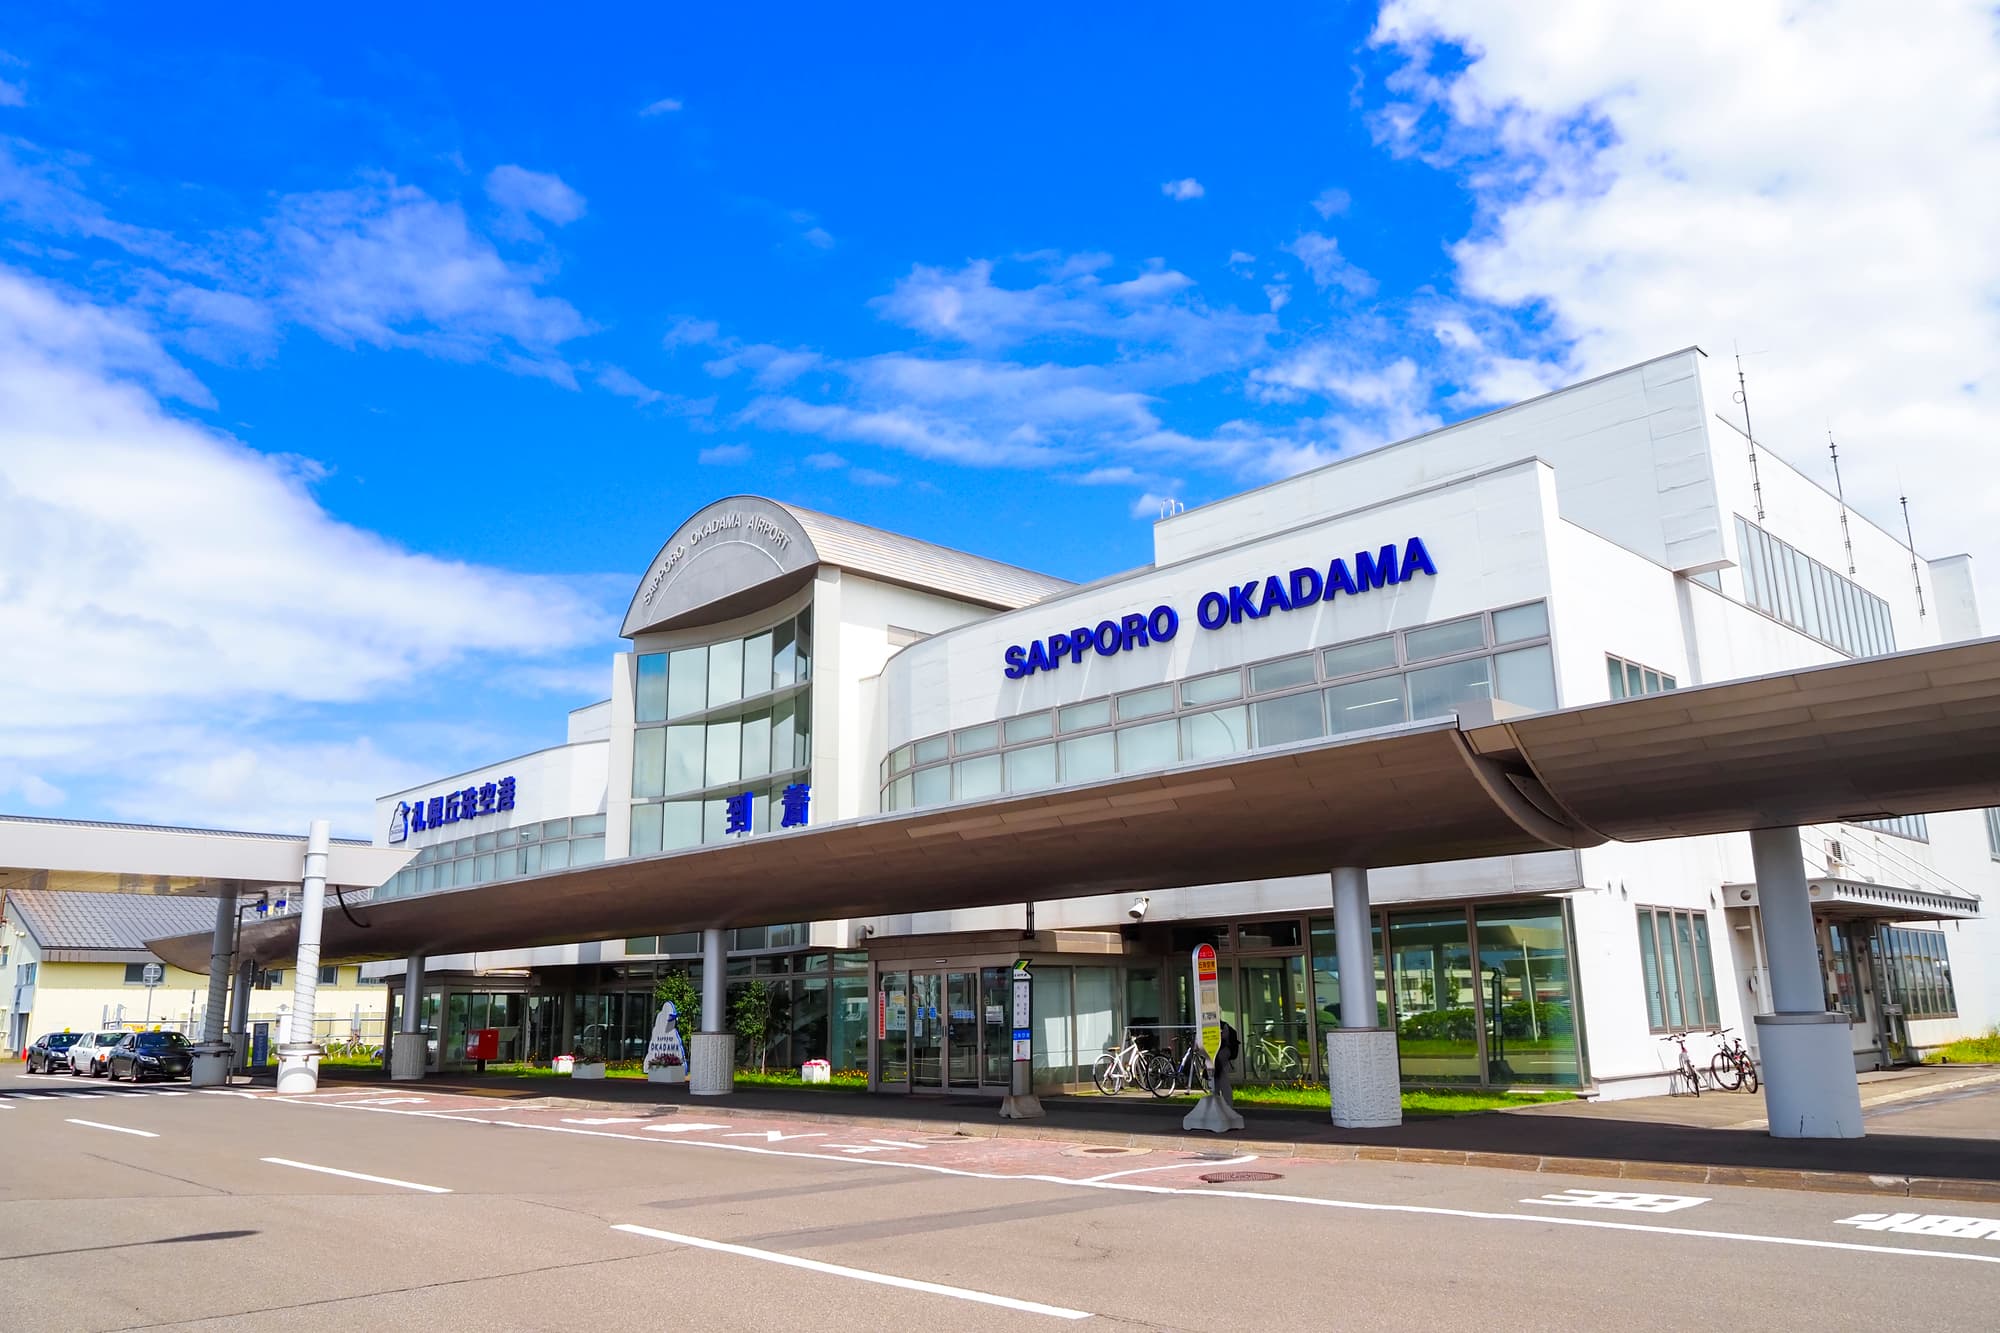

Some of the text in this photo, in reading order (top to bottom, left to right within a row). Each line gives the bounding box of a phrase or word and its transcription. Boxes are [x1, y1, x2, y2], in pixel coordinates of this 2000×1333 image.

[644, 513, 792, 605] SAPPORO OKADAMA AIRPORT
[1004, 536, 1437, 679] SAPPORO OKADAMA
[411, 776, 516, 833] 札幌丘珠空港
[725, 784, 810, 835] 到着
[650, 1043, 679, 1051] OKADAMA
